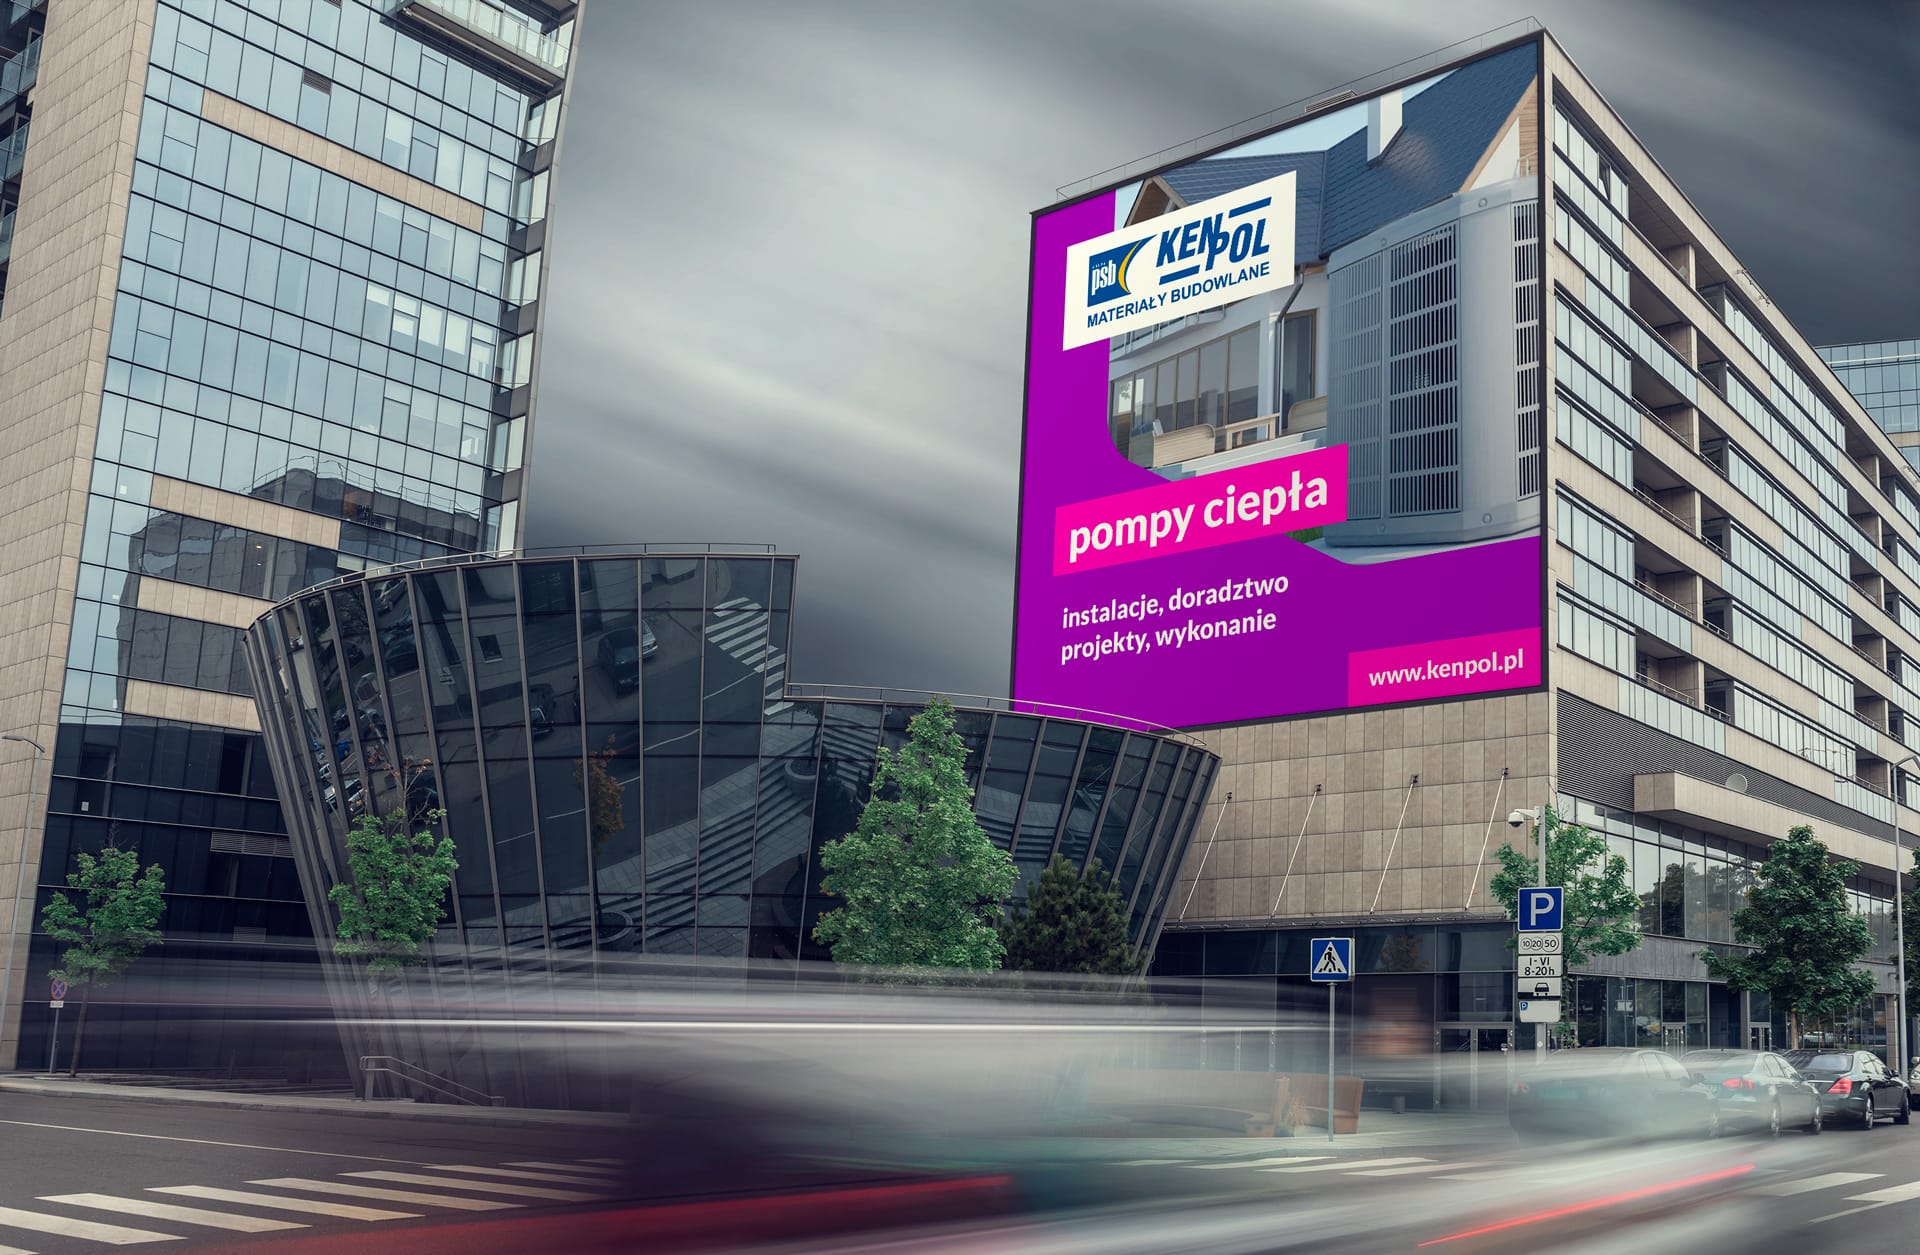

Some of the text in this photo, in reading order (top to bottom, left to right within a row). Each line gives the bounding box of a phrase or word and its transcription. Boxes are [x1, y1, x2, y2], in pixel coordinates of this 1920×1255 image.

[1087, 261, 1270, 328] MATERIAŁY BUDOWLANE
[1091, 259, 1117, 296] psb
[1069, 470, 1327, 563] pompy ciepła
[1062, 575, 1289, 629] instalacje, doradztwo
[1061, 608, 1277, 665] projekty, wykonanie
[1368, 648, 1524, 687] www.kenpol.pl
[1530, 892, 1555, 926] P
[1522, 938, 1556, 948] 10 20 50
